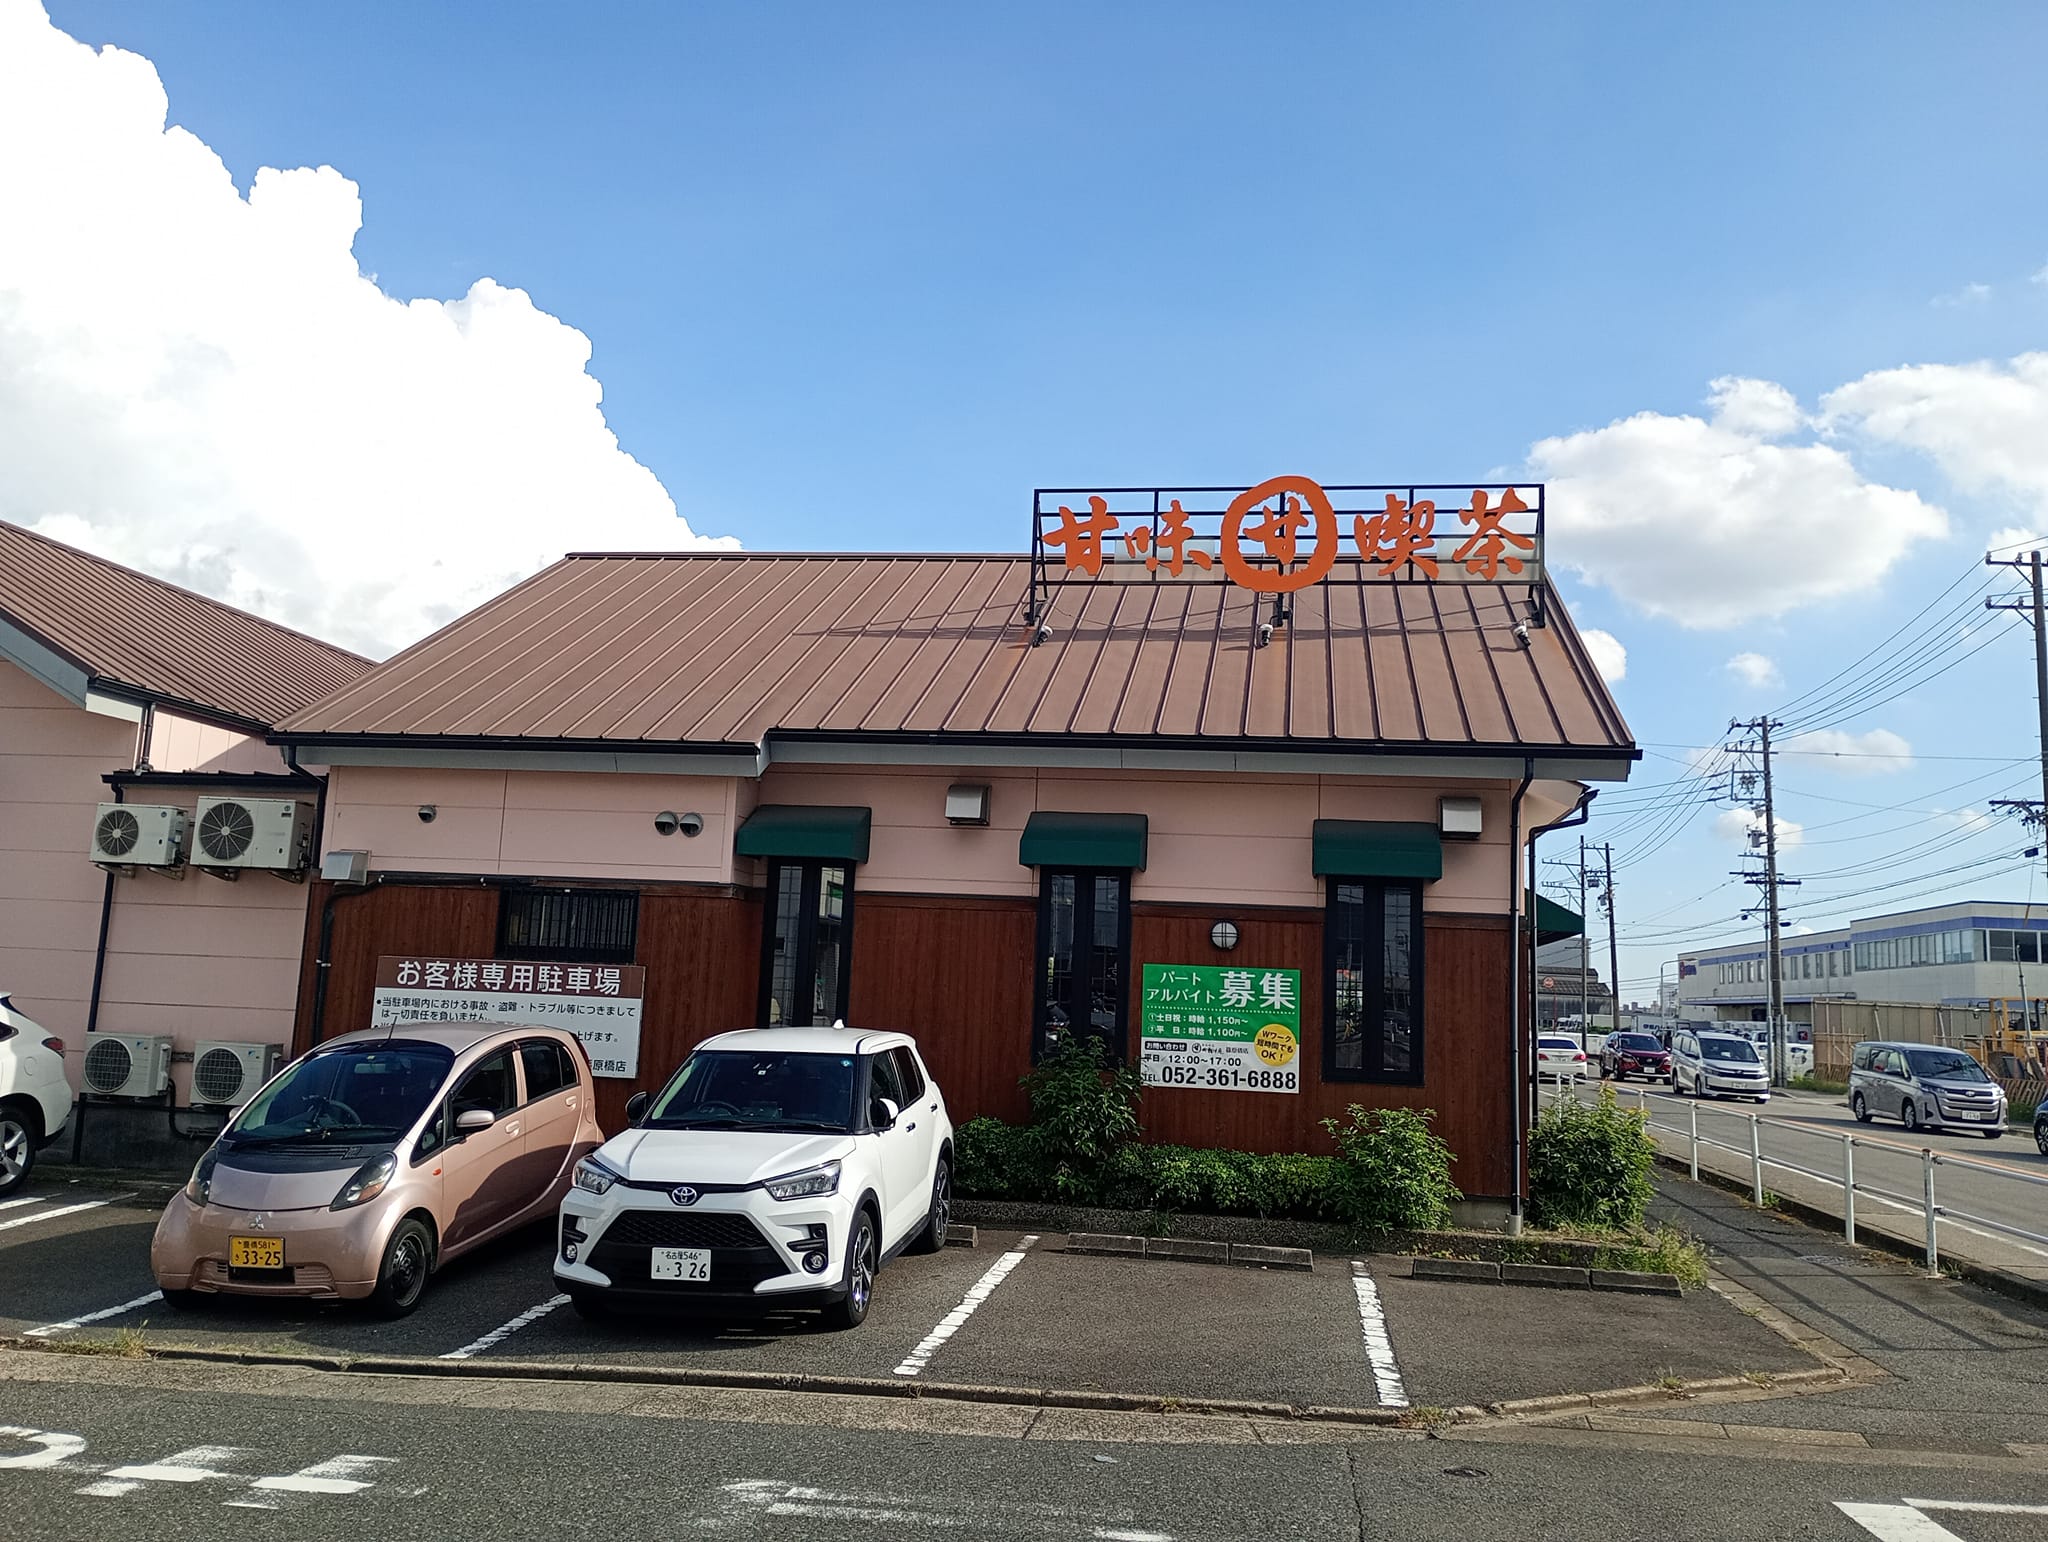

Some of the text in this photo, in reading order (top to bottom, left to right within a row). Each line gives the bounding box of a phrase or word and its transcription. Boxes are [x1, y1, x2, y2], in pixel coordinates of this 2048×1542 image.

[1042, 495, 1213, 578] 甘味
[1353, 486, 1536, 581] 喫茶
[396, 960, 622, 996] お客様専用駐車場
[1160, 971, 1201, 986] パート
[1146, 987, 1216, 1005] アルバイト
[1219, 970, 1297, 1010] 募集
[1262, 1029, 1292, 1043] Wワーク
[1146, 1041, 1187, 1052] お問い合わせ
[1261, 1049, 1284, 1062] OK!
[1161, 1065, 1297, 1090] 052-361-6888
[242, 1250, 281, 1266] 33-25
